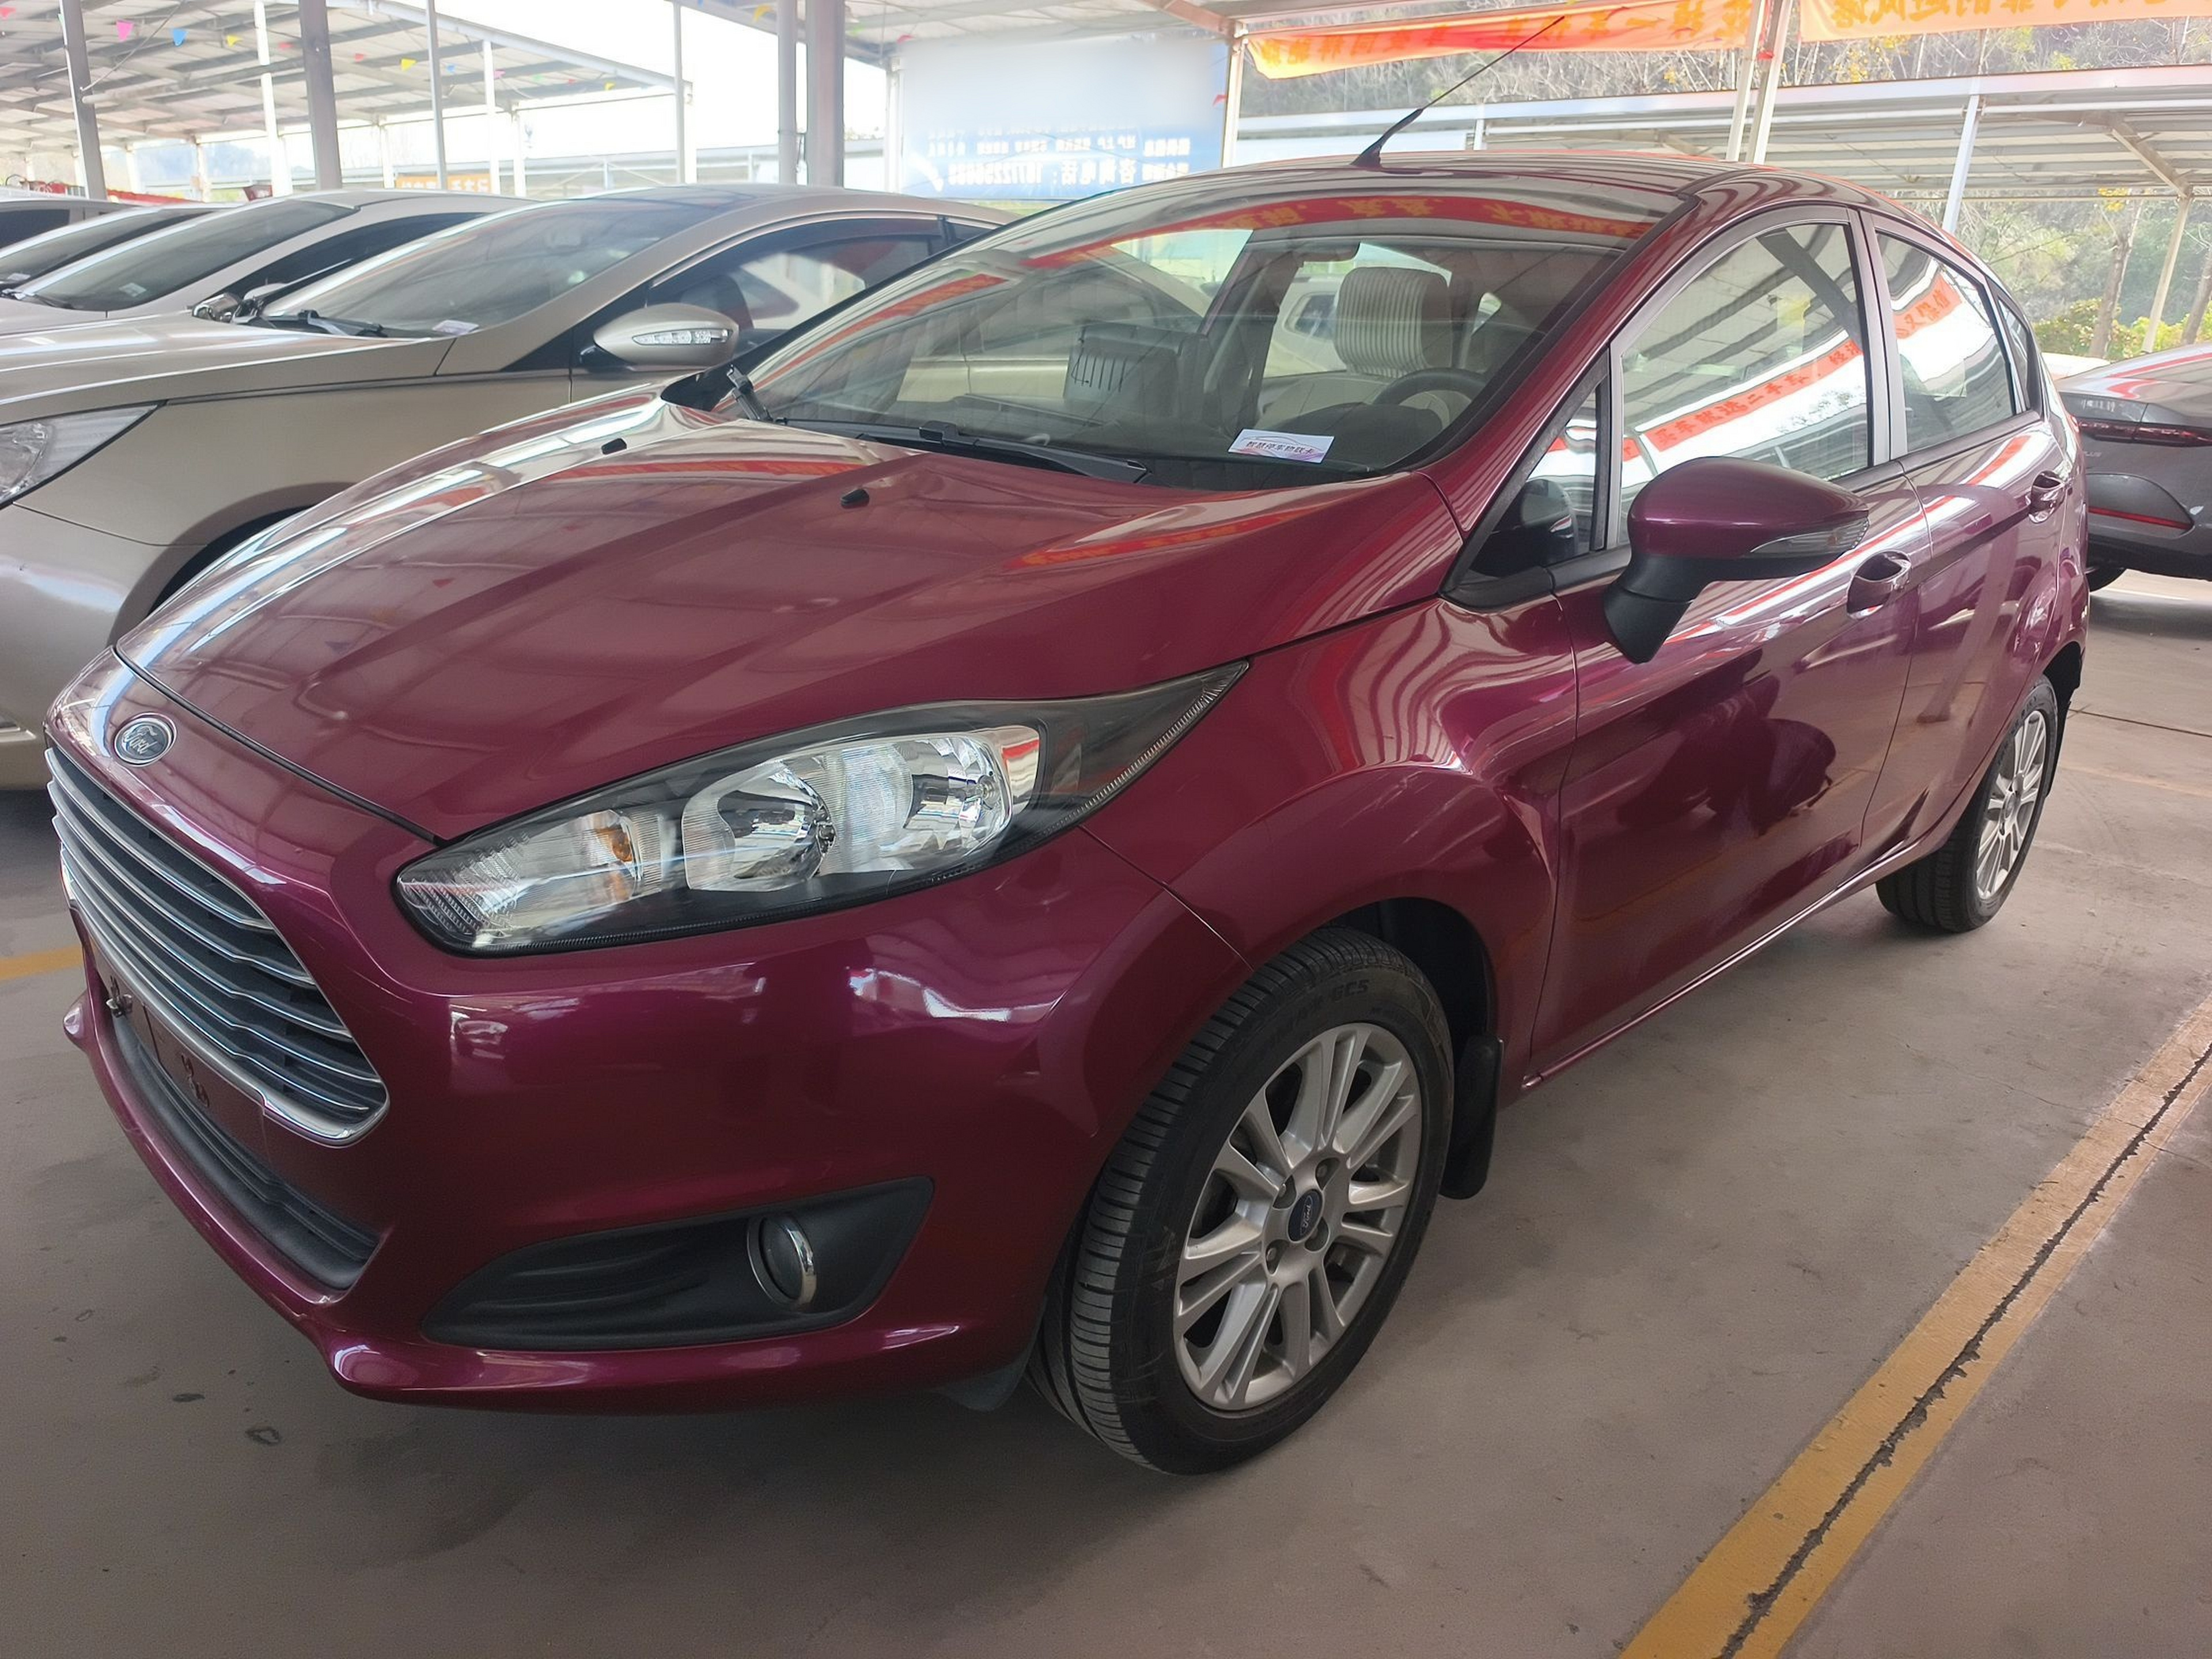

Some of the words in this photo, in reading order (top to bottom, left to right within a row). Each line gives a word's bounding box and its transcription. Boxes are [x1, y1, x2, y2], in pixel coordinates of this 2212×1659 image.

[1246, 441, 1314, 454] 智慧停车物联卡
